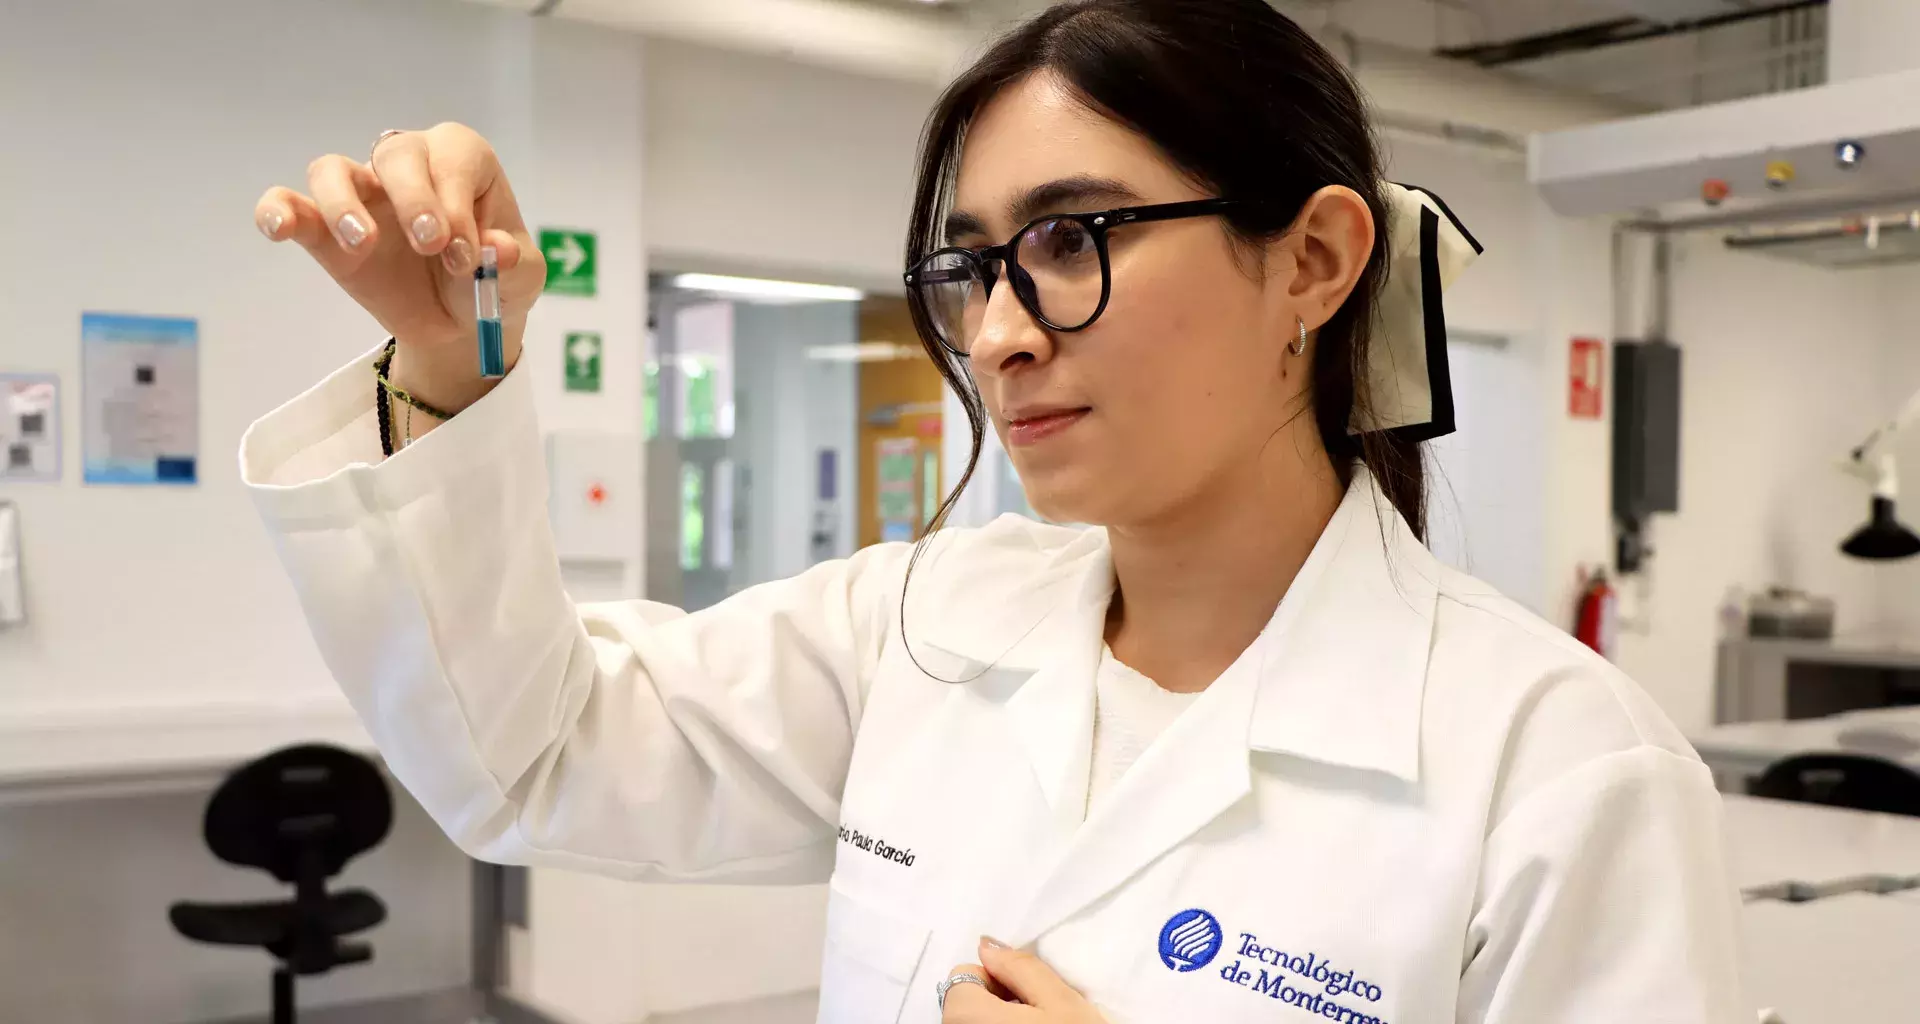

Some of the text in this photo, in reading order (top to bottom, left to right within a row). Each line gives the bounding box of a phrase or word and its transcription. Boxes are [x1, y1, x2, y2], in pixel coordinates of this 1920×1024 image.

[851, 830, 873, 852] Paula
[874, 840, 916, 867] García
[1220, 961, 1388, 1024] de Monterre
[1237, 933, 1382, 1002] Tecnológico
